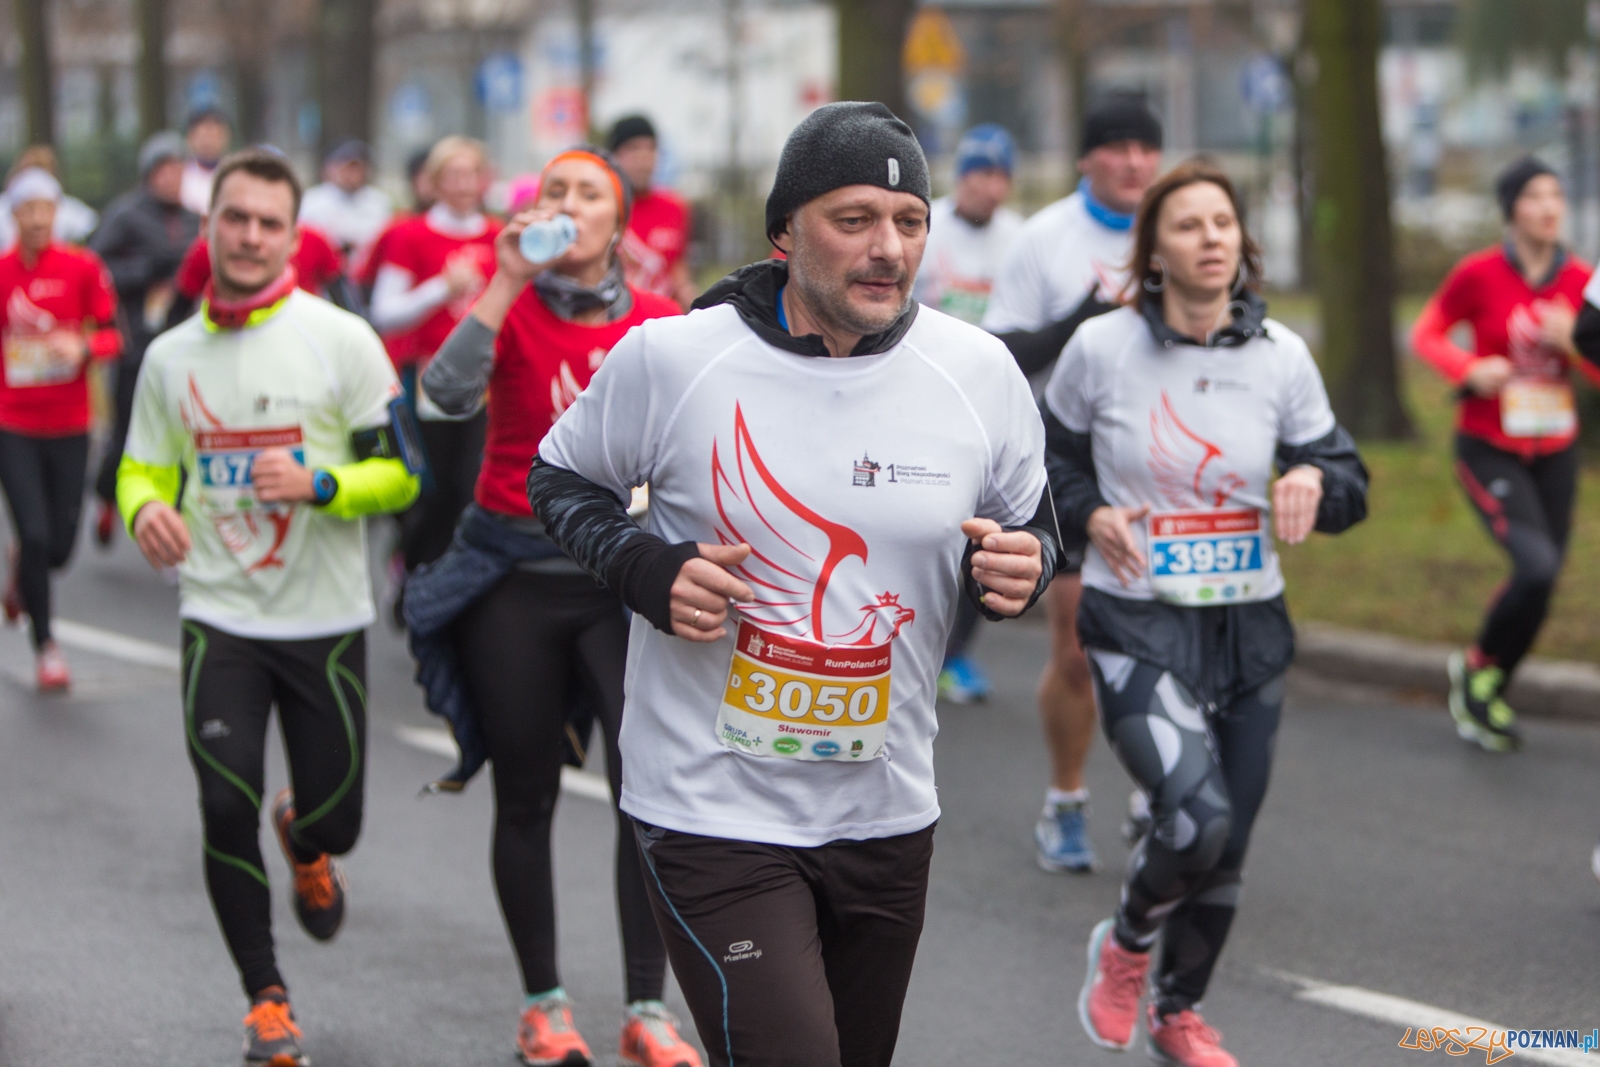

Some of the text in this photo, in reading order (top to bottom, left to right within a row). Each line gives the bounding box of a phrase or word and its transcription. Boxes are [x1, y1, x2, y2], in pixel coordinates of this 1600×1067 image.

[886, 464, 898, 482] 1
[1167, 538, 1254, 574] 3957
[766, 643, 774, 658] 1
[825, 656, 888, 669] RunPoland.org
[730, 671, 879, 722] D 3050
[722, 730, 751, 747] LUXMED
[724, 723, 747, 738] GRUPA
[777, 724, 832, 737] Sławomir
